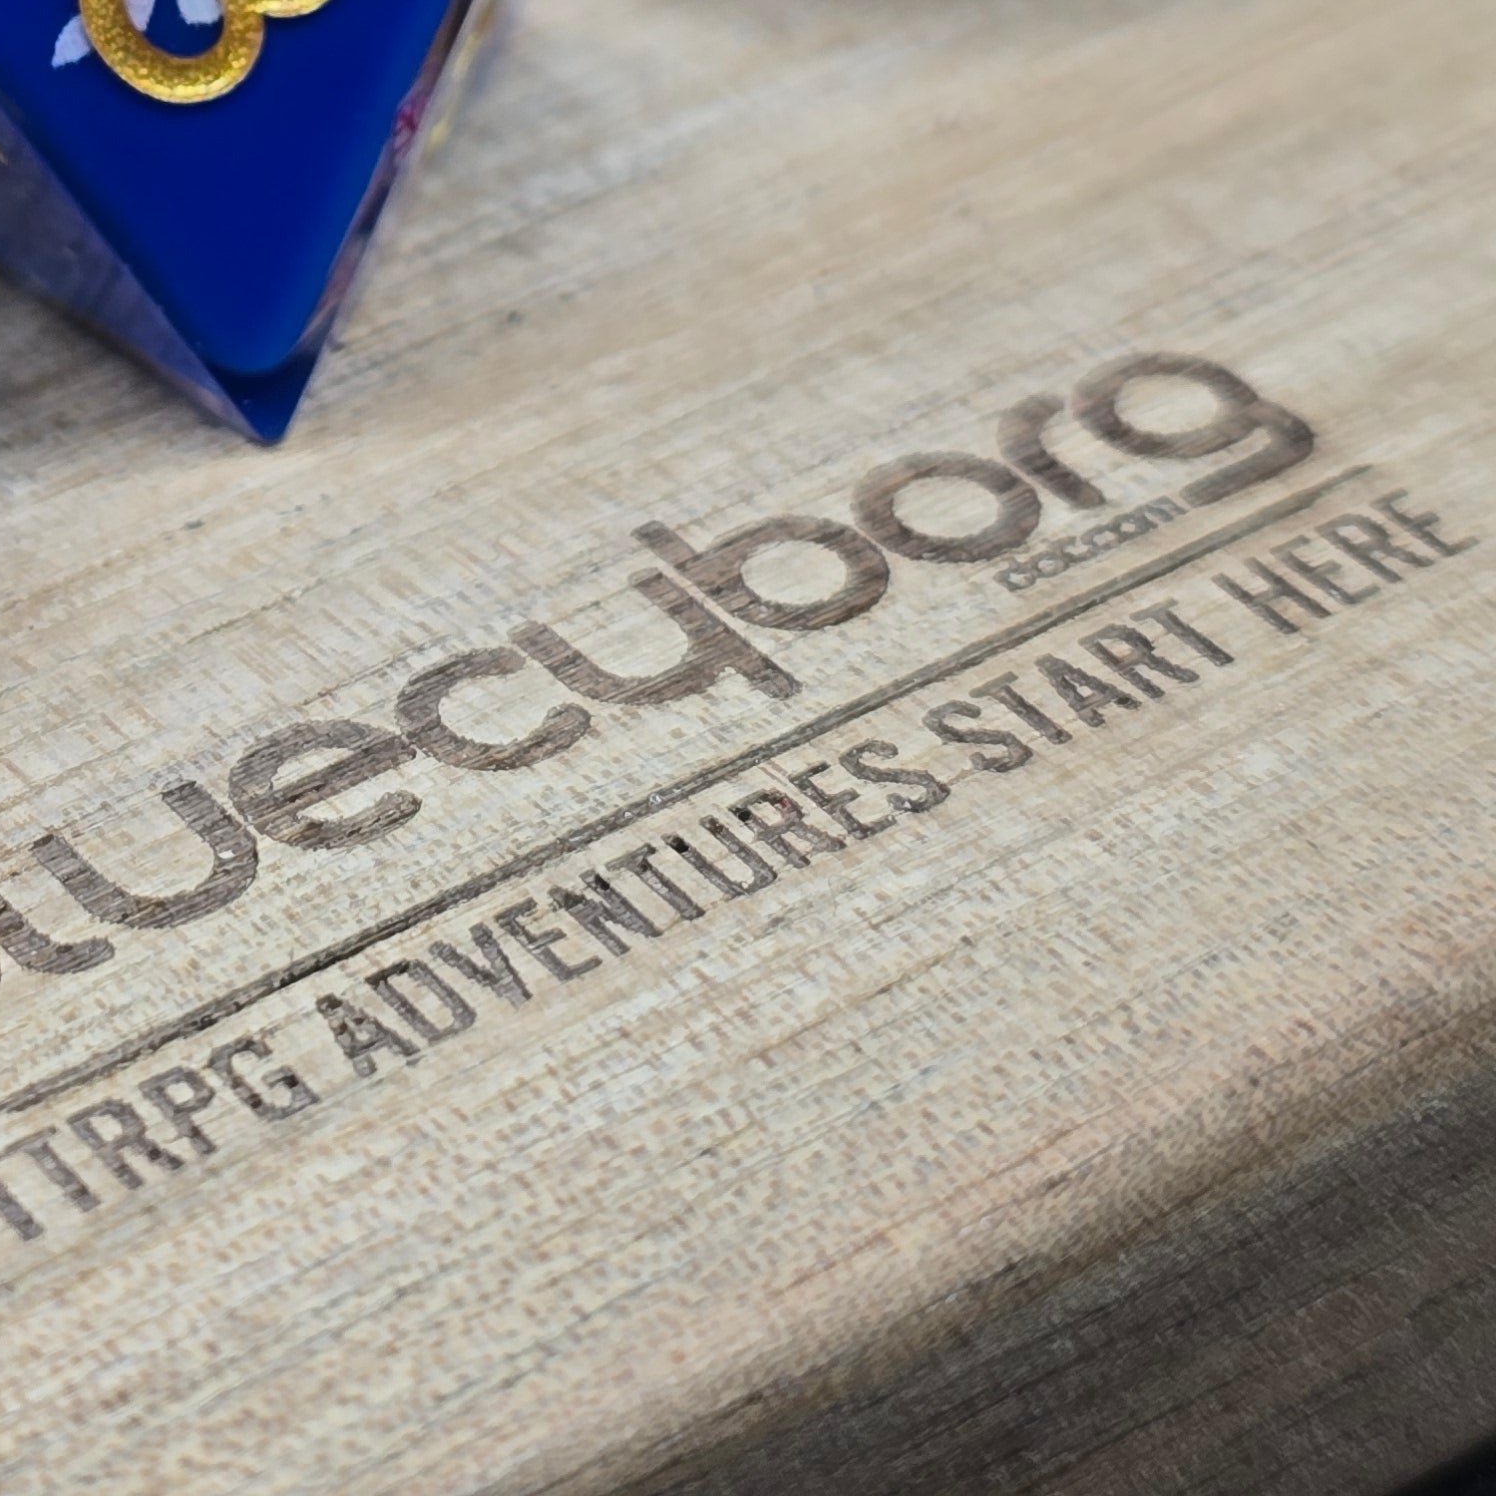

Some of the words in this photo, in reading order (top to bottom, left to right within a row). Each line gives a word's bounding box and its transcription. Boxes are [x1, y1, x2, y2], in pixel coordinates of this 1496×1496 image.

[315, 737, 952, 1076] ADVENTURES
[922, 598, 1235, 774] START
[1211, 487, 1480, 635] HERE
